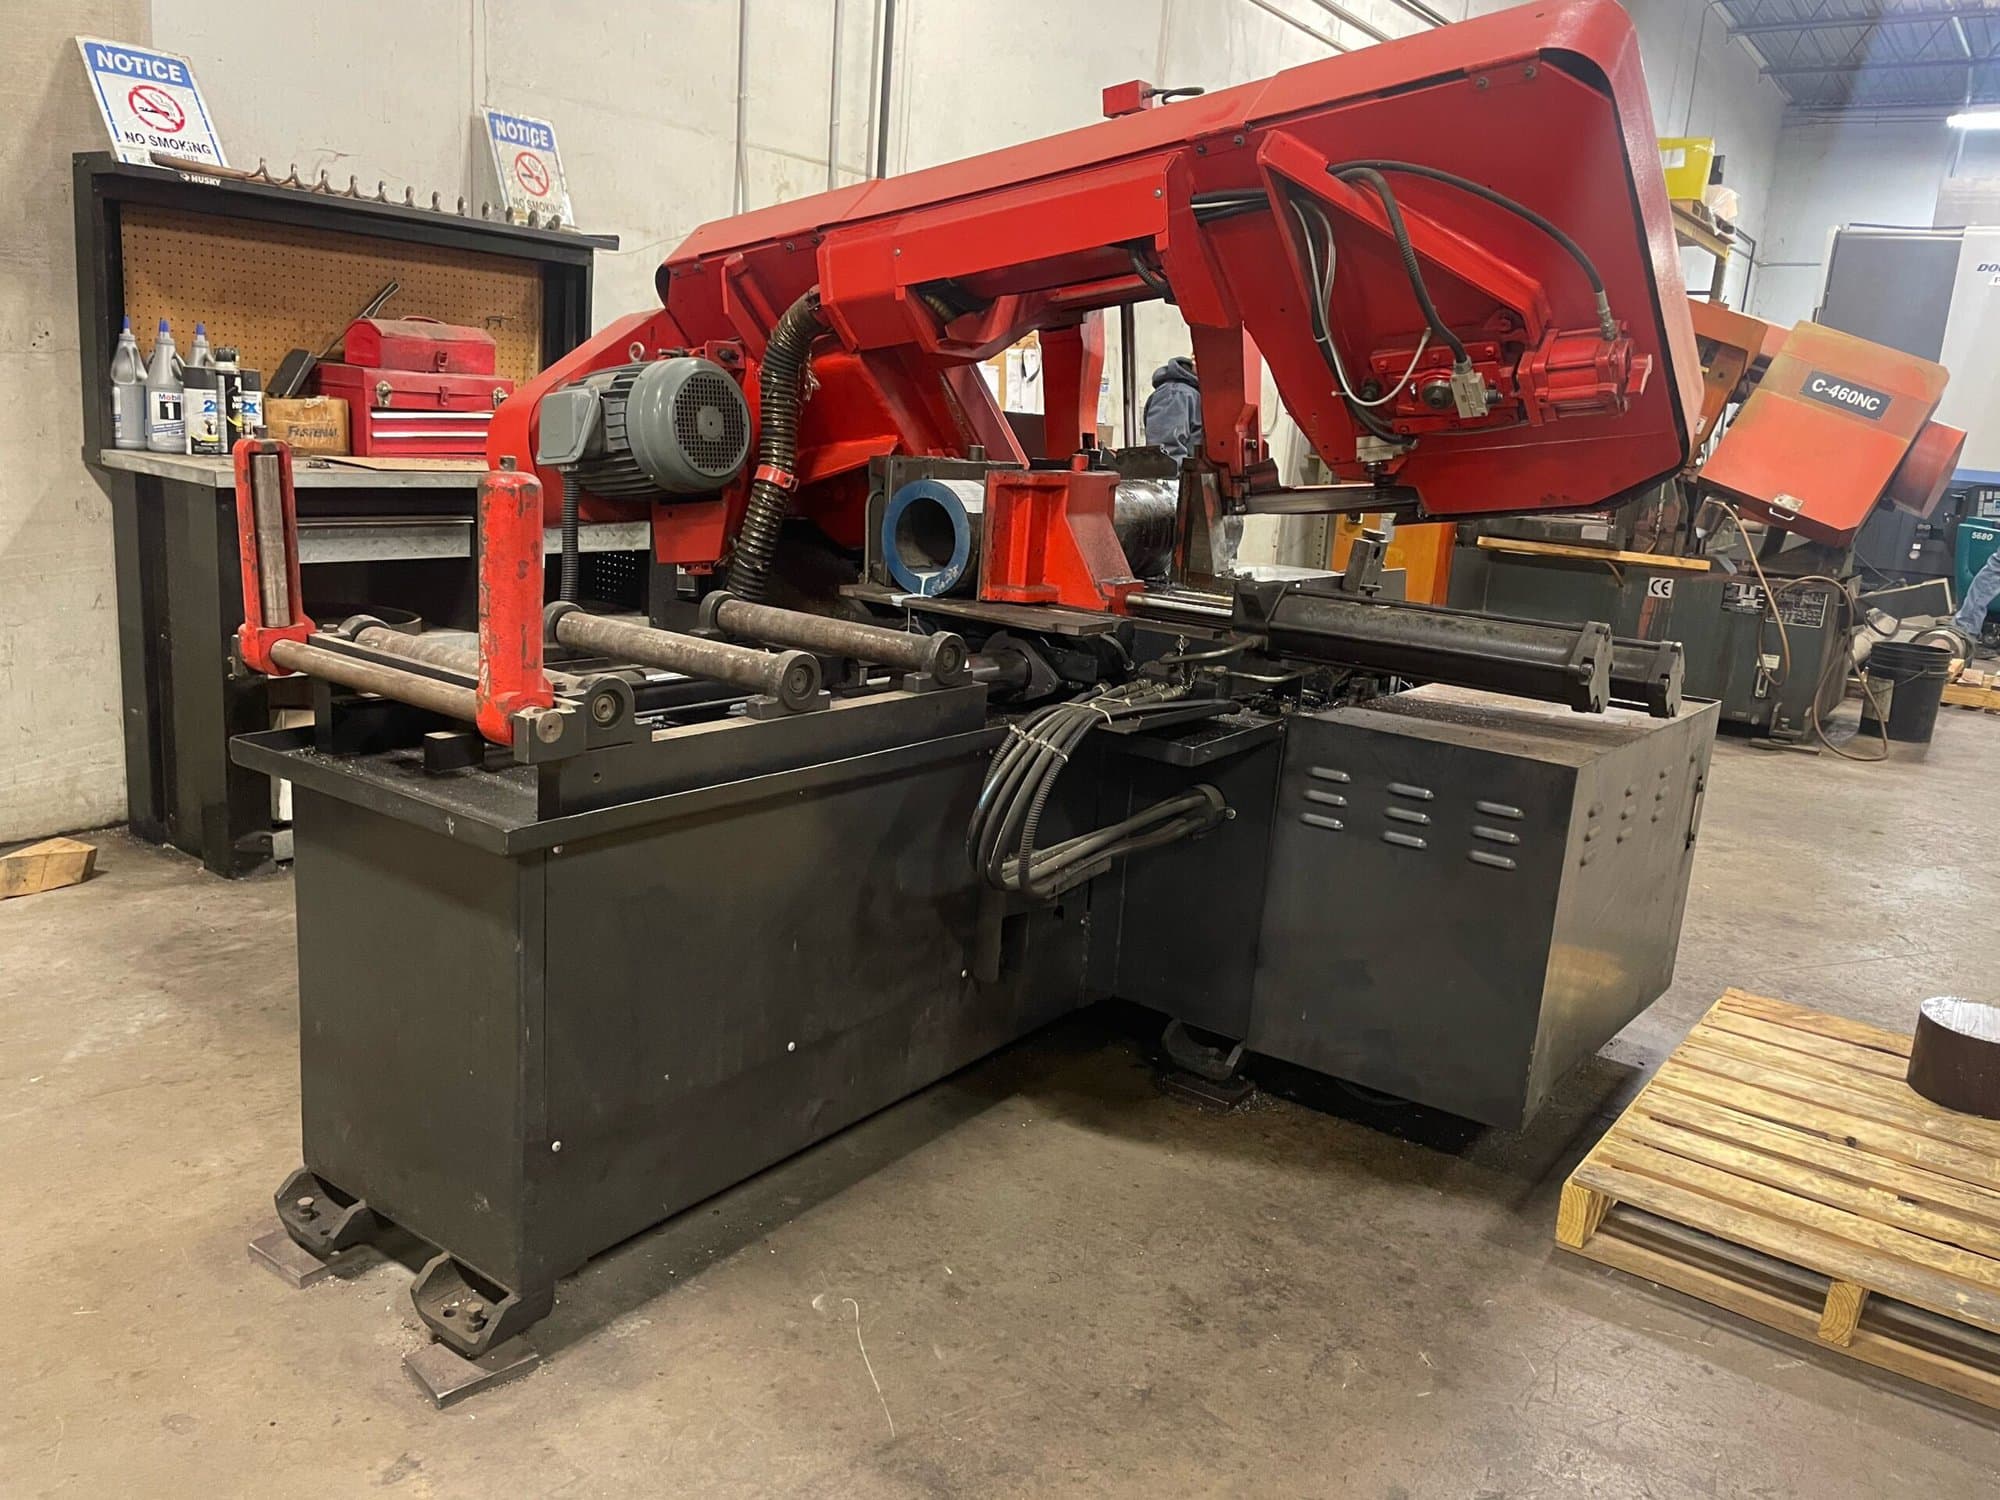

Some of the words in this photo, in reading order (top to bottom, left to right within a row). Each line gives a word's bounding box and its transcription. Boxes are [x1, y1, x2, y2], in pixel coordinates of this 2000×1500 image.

[96, 49, 183, 82] NOTICE
[124, 131, 145, 144] NO
[148, 135, 211, 154] SMOKING
[495, 119, 549, 147] NOTICE
[191, 174, 221, 186] HUSKY
[1812, 379, 1880, 411] C-460NC
[1971, 531, 1994, 541] 5680
[1651, 579, 1671, 596] CE
